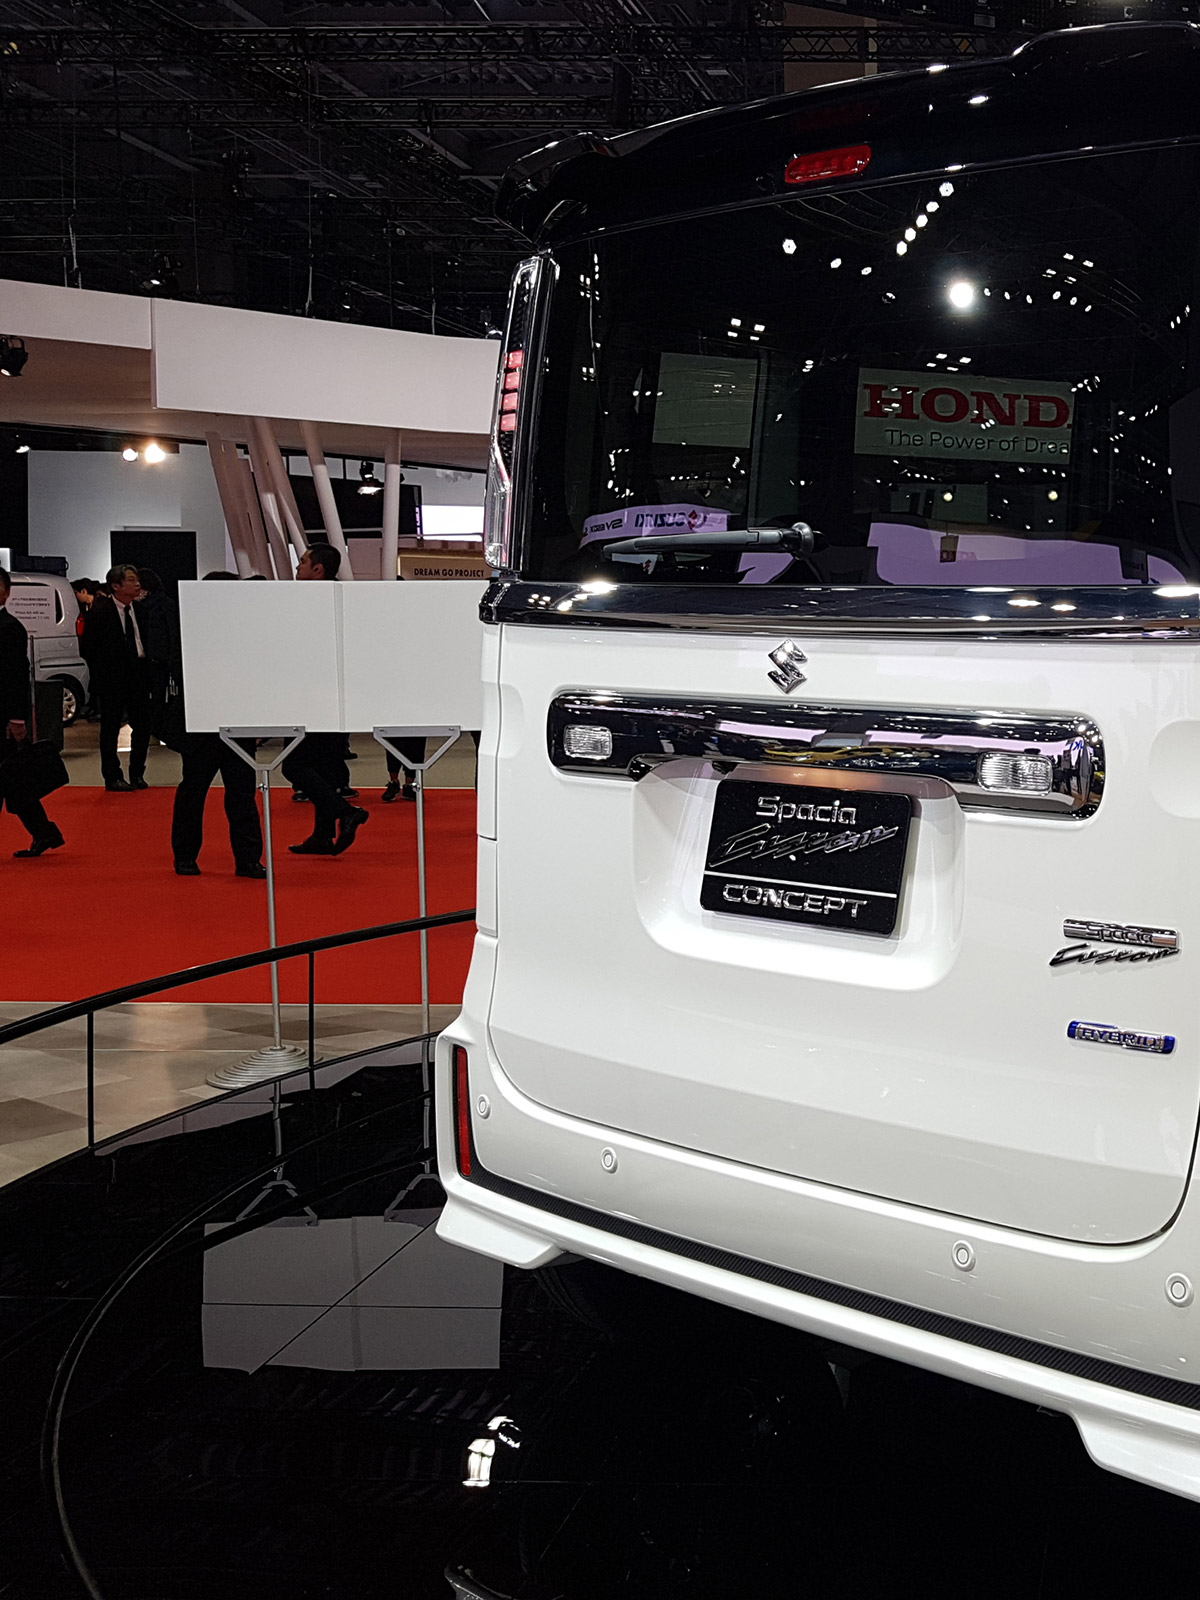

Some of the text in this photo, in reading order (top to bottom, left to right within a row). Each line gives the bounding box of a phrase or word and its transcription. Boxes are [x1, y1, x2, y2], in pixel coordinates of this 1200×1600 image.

[863, 384, 1073, 429] HOND
[885, 429, 924, 447] The
[930, 431, 995, 450] Power
[998, 436, 1020, 452] of
[414, 568, 485, 578] DREAM GO PROJECT
[756, 795, 857, 825] Spacia
[708, 822, 899, 868] Custom
[722, 883, 868, 918] CONCEPT
[1048, 942, 1181, 967] Custom
[1080, 1027, 1158, 1048] HYBRID
